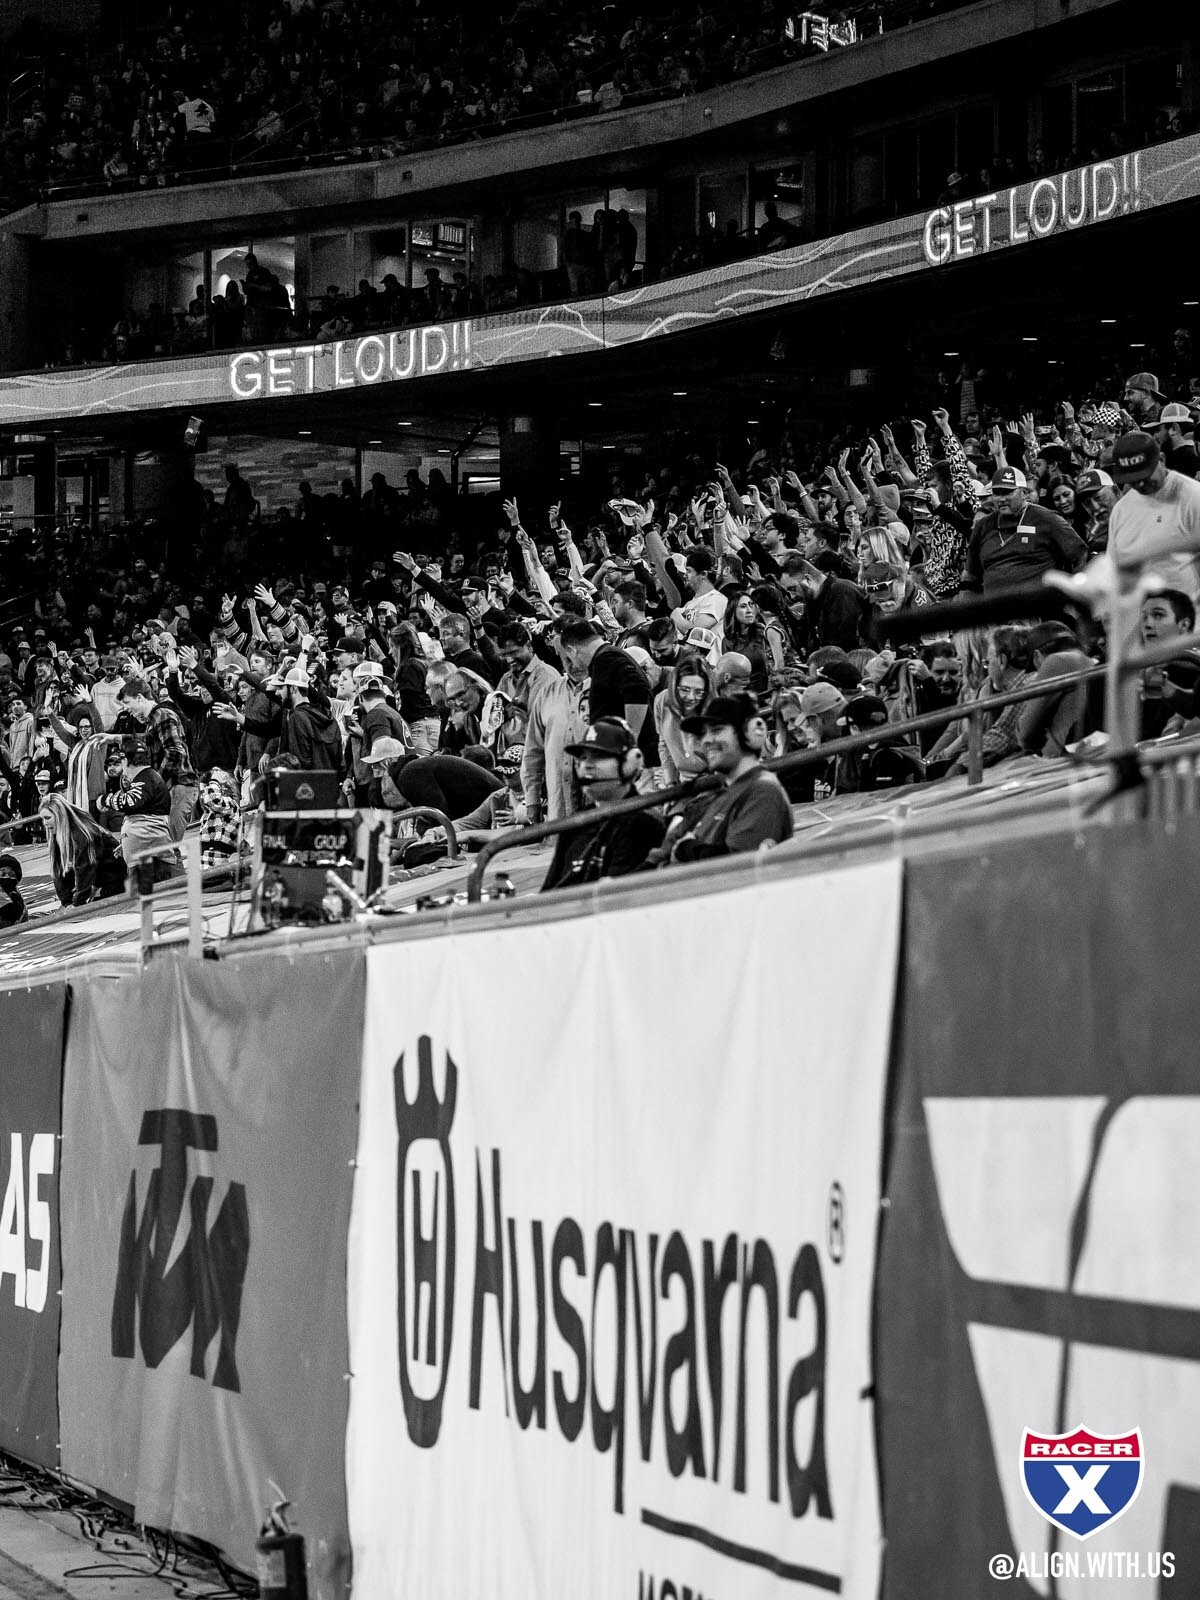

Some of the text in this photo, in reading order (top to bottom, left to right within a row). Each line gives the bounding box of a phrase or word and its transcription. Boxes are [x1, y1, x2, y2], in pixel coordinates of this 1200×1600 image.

[924, 153, 1140, 263] GET LOUD!!
[230, 321, 471, 396] GET LOUD!!
[469, 1145, 836, 1521] Husqvarna
